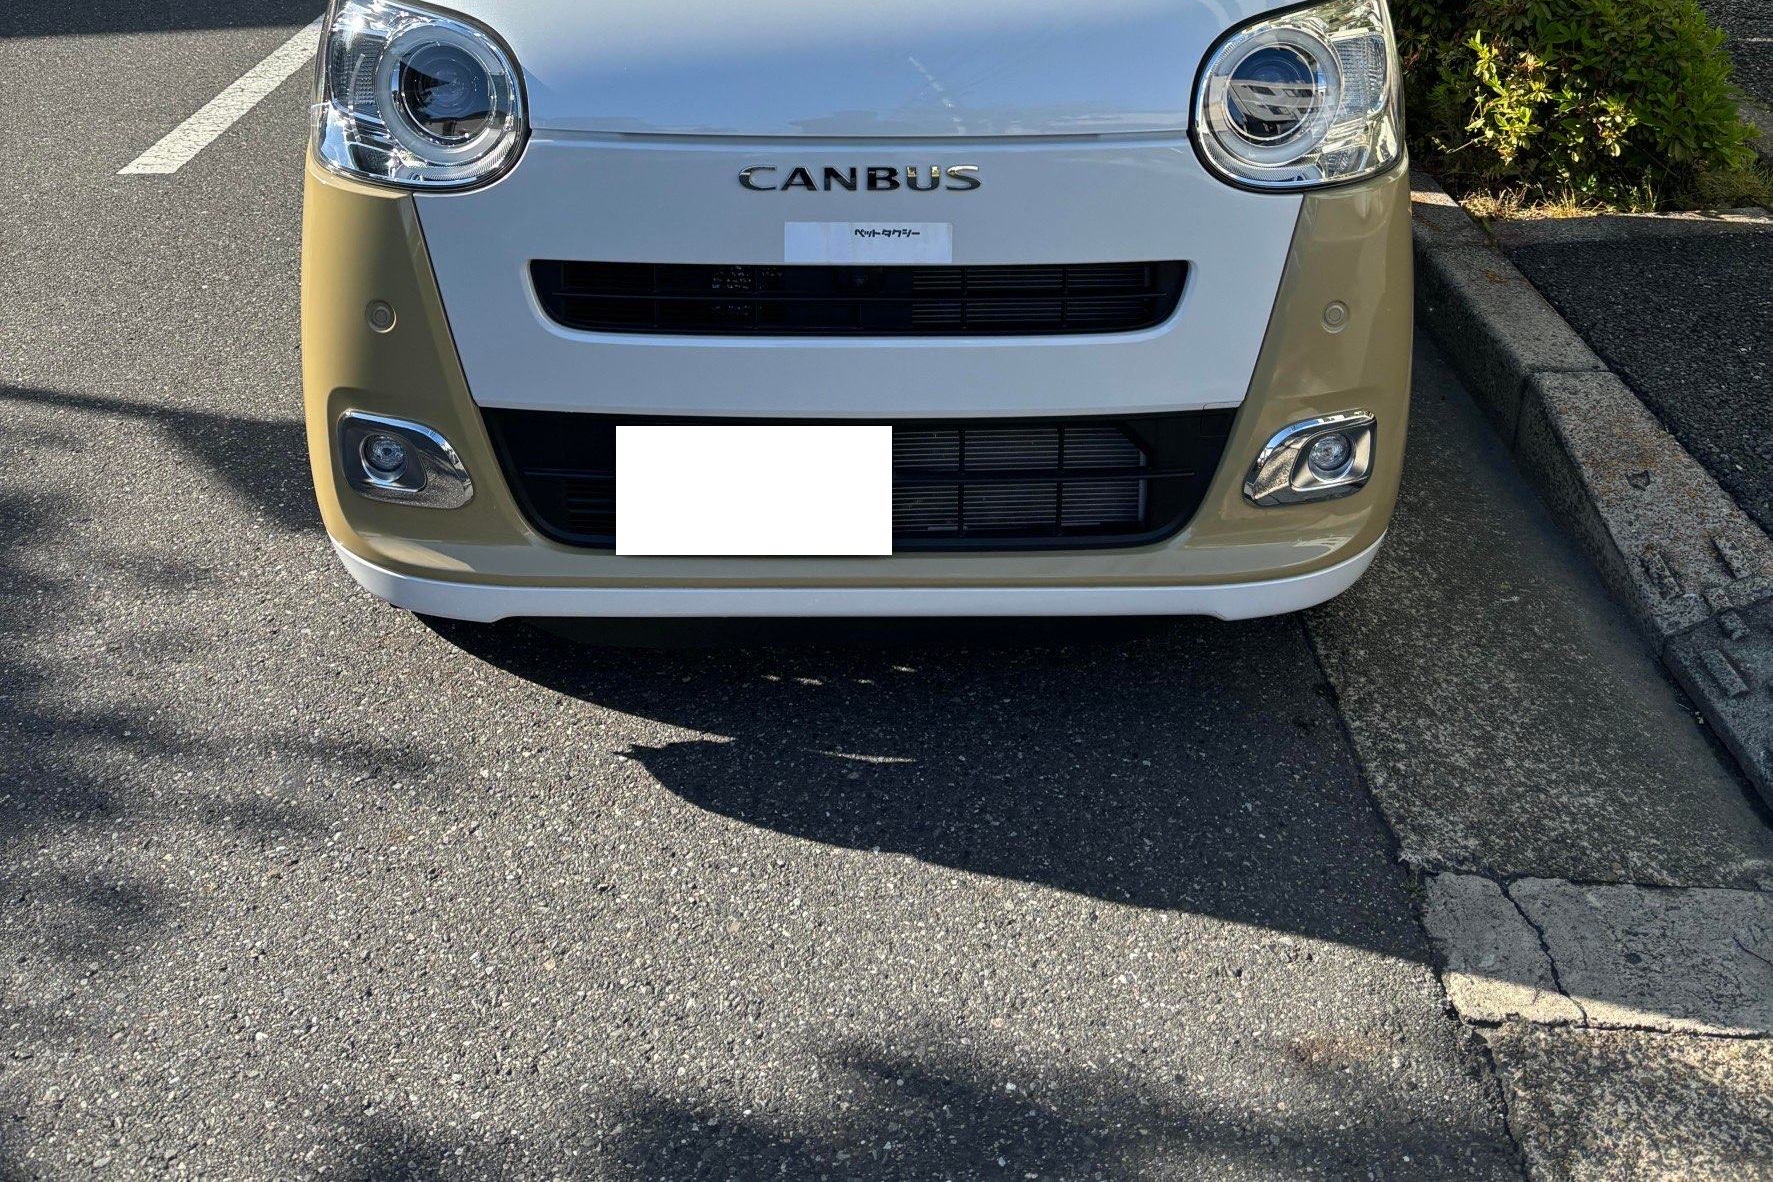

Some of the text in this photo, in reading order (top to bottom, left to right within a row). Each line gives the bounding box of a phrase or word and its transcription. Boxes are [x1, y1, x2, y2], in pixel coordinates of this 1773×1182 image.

[738, 165, 982, 192] CANBUS
[854, 228, 921, 238] ペットタクシー
